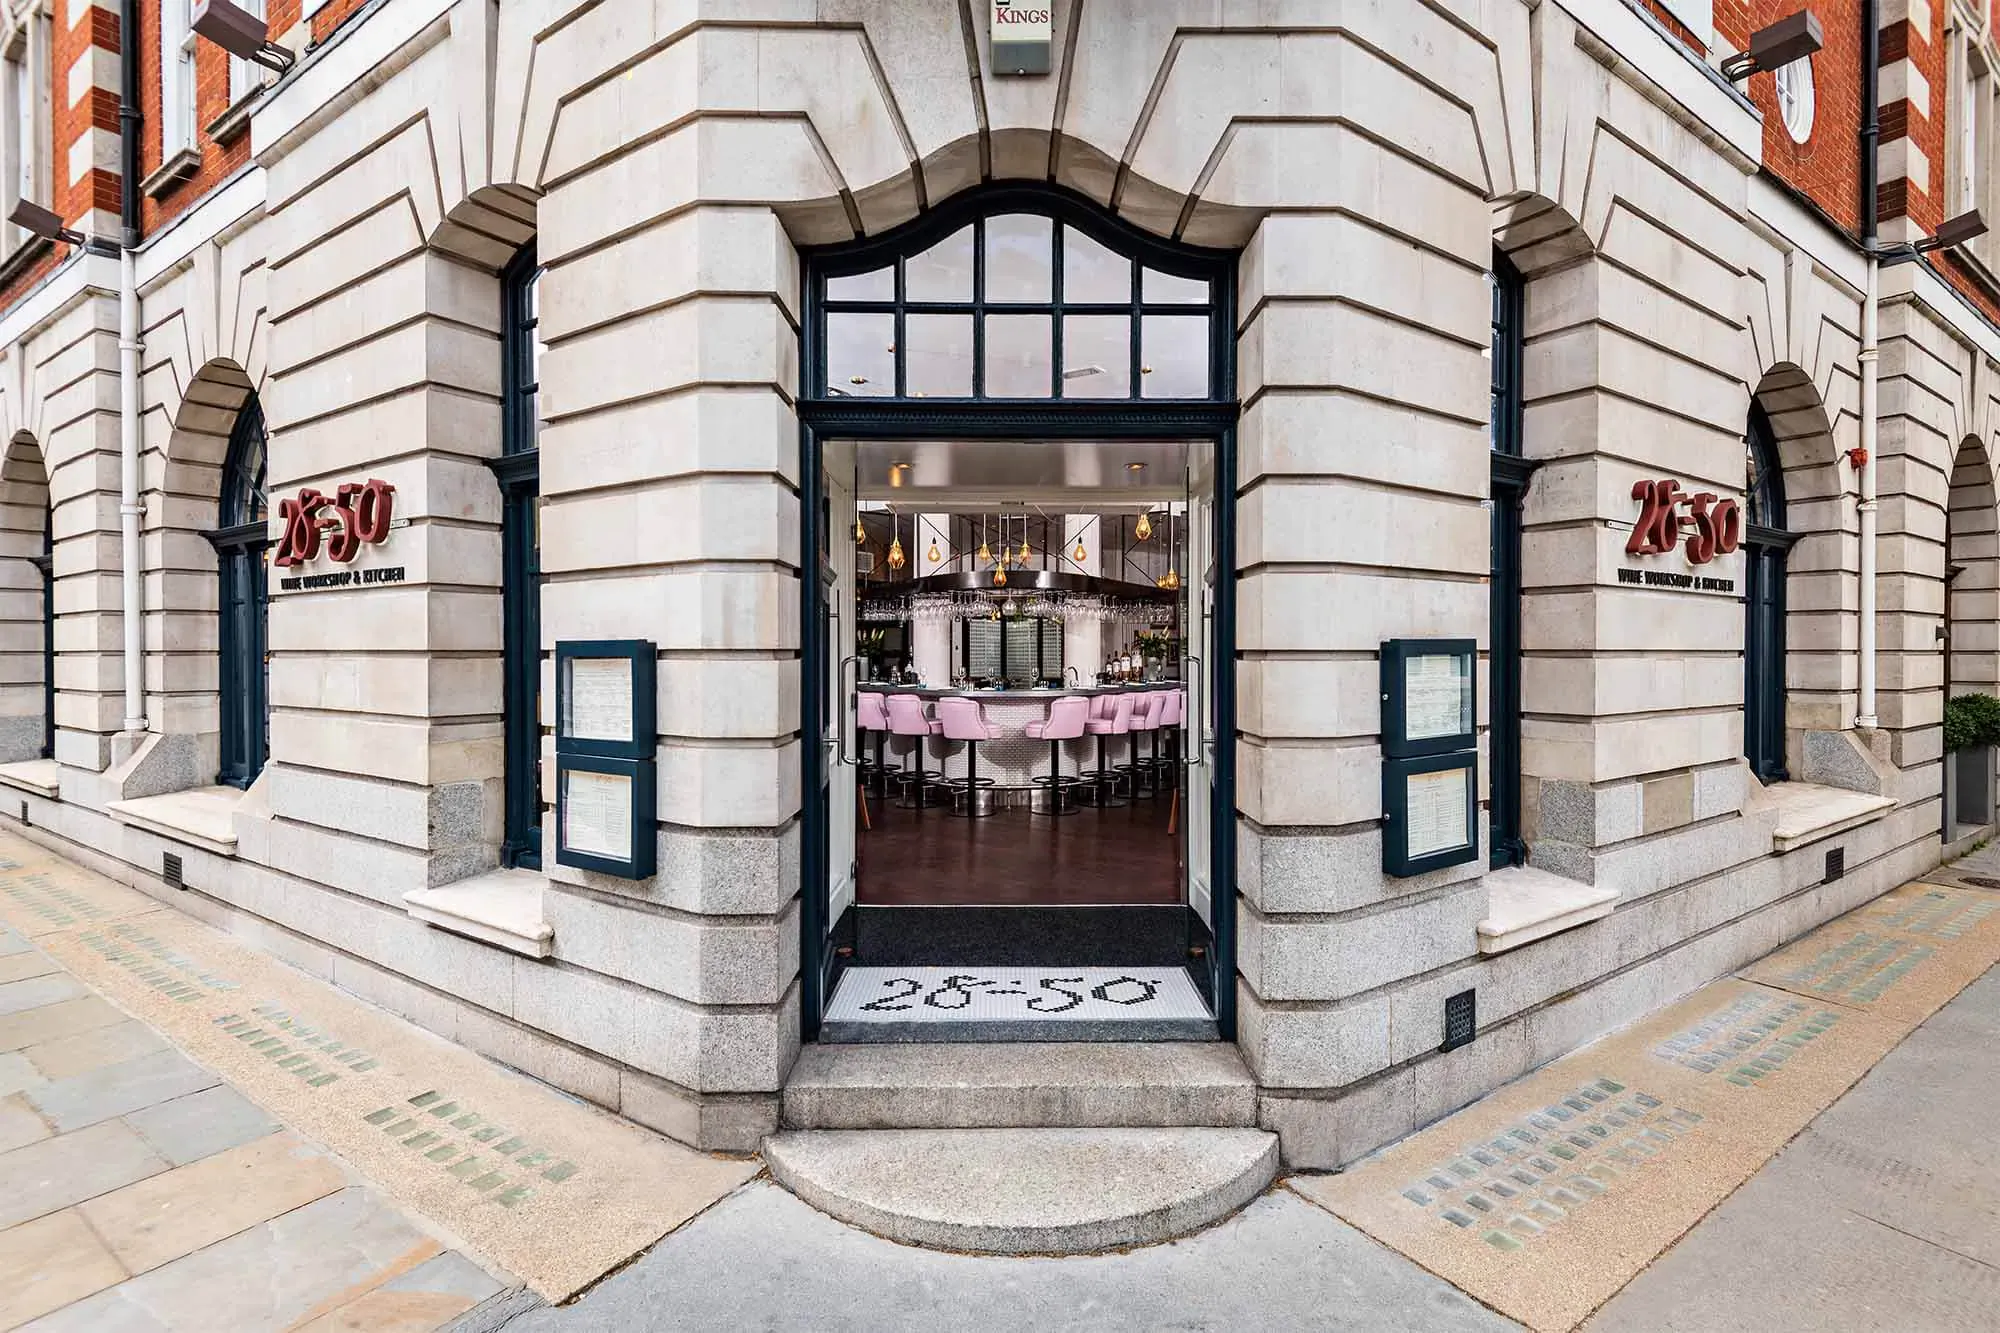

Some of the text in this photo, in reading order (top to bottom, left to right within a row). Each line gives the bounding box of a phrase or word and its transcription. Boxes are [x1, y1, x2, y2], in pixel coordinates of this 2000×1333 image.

[996, 7, 1049, 24] KINGS
[280, 566, 405, 590] WINE WORKSHOP & KITCHEN
[1617, 568, 1643, 584] WINE
[1644, 570, 1694, 588] WORKSHOP
[1694, 576, 1702, 590] &
